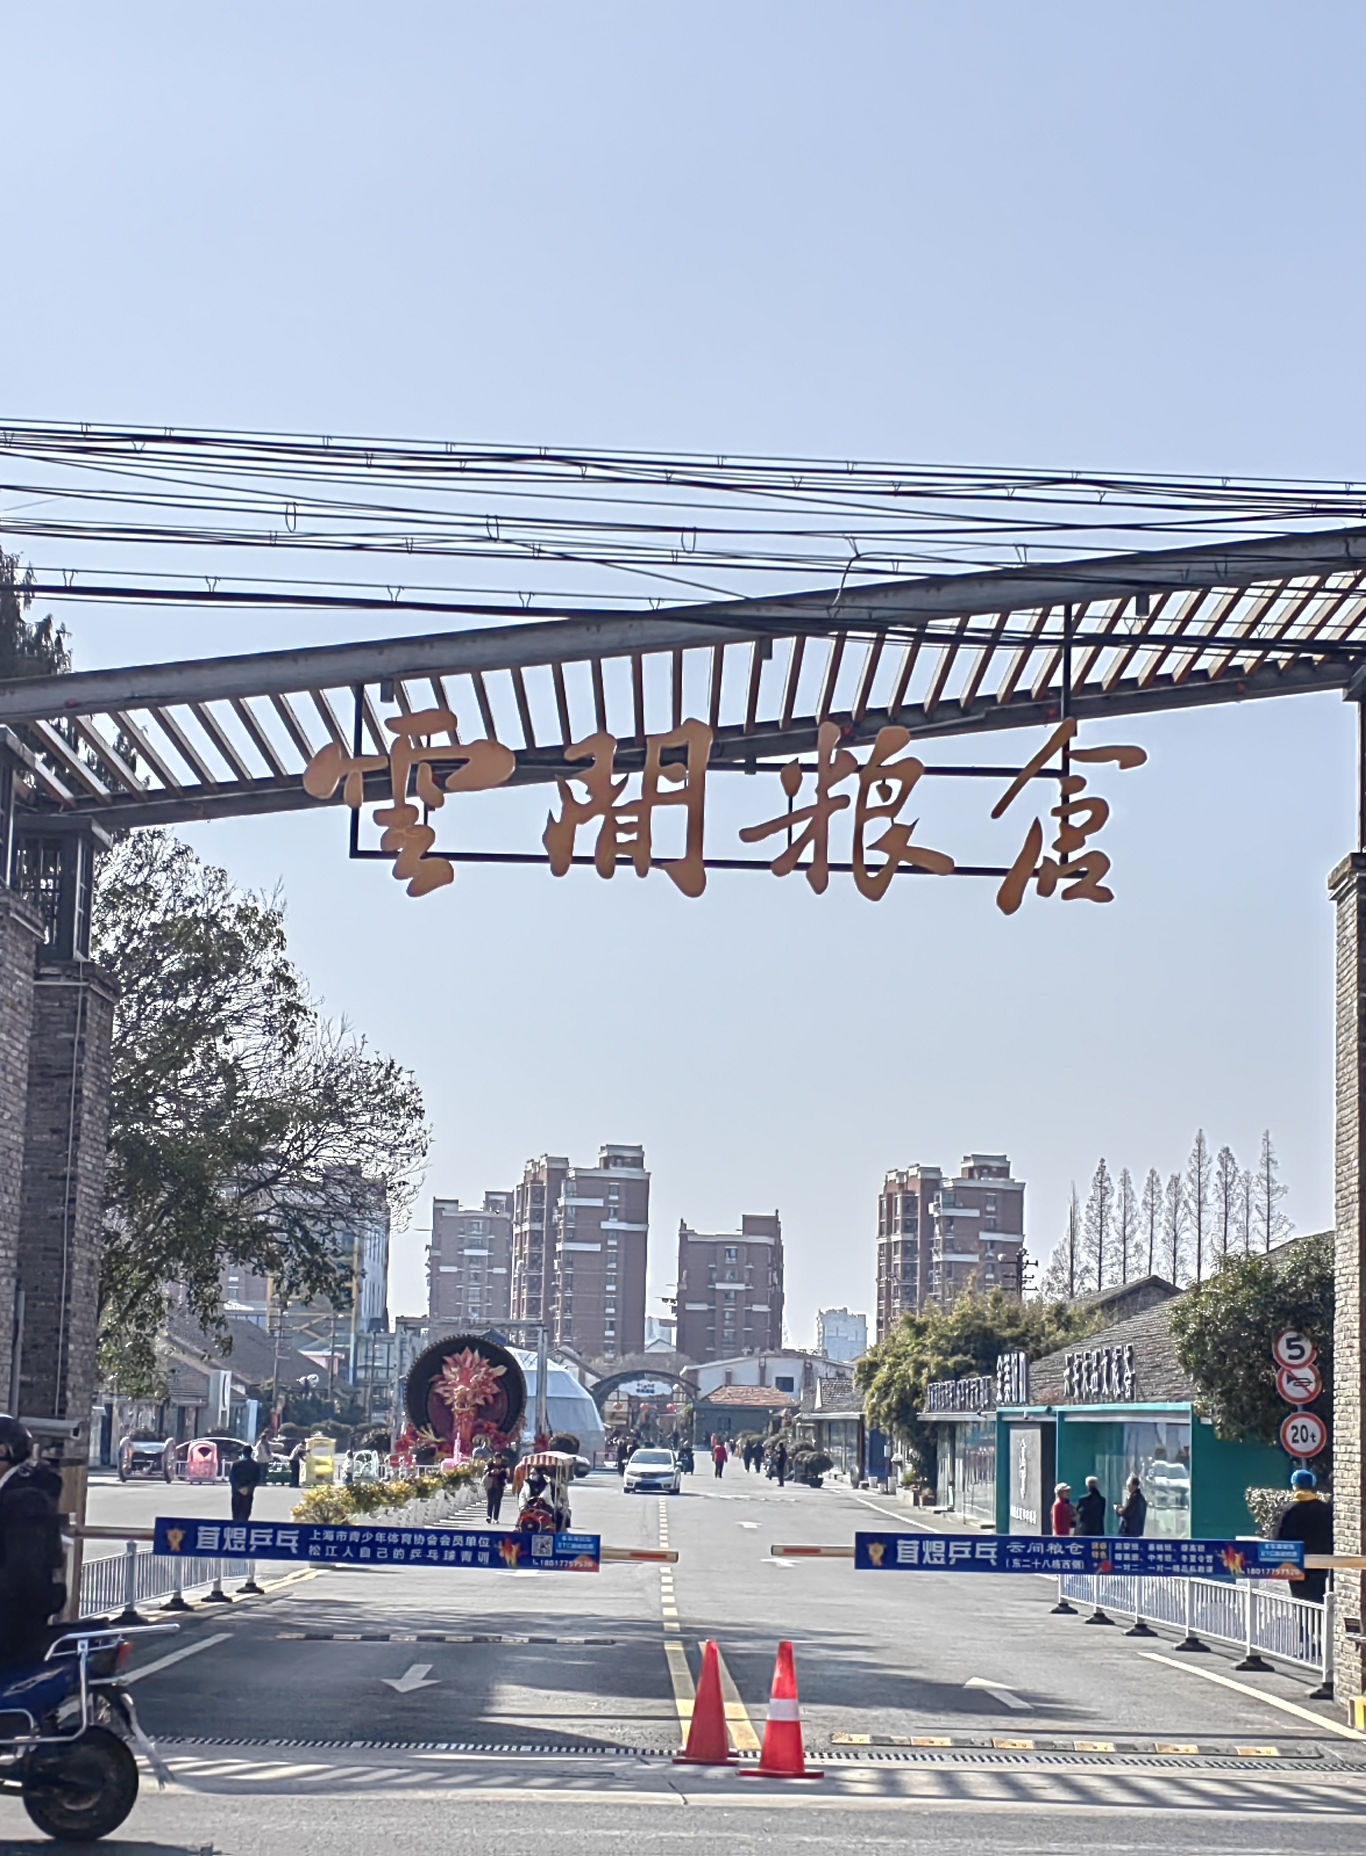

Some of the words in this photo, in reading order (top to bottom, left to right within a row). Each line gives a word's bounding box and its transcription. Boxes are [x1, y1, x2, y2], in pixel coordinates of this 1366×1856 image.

[1285, 1337, 1306, 1360] 5
[309, 1529, 491, 1548] 上海市青少年体育协会会员单位
[1005, 1541, 1085, 1555] 云间粮仓
[308, 1545, 491, 1565] 松江人自己的乒乓球青训
